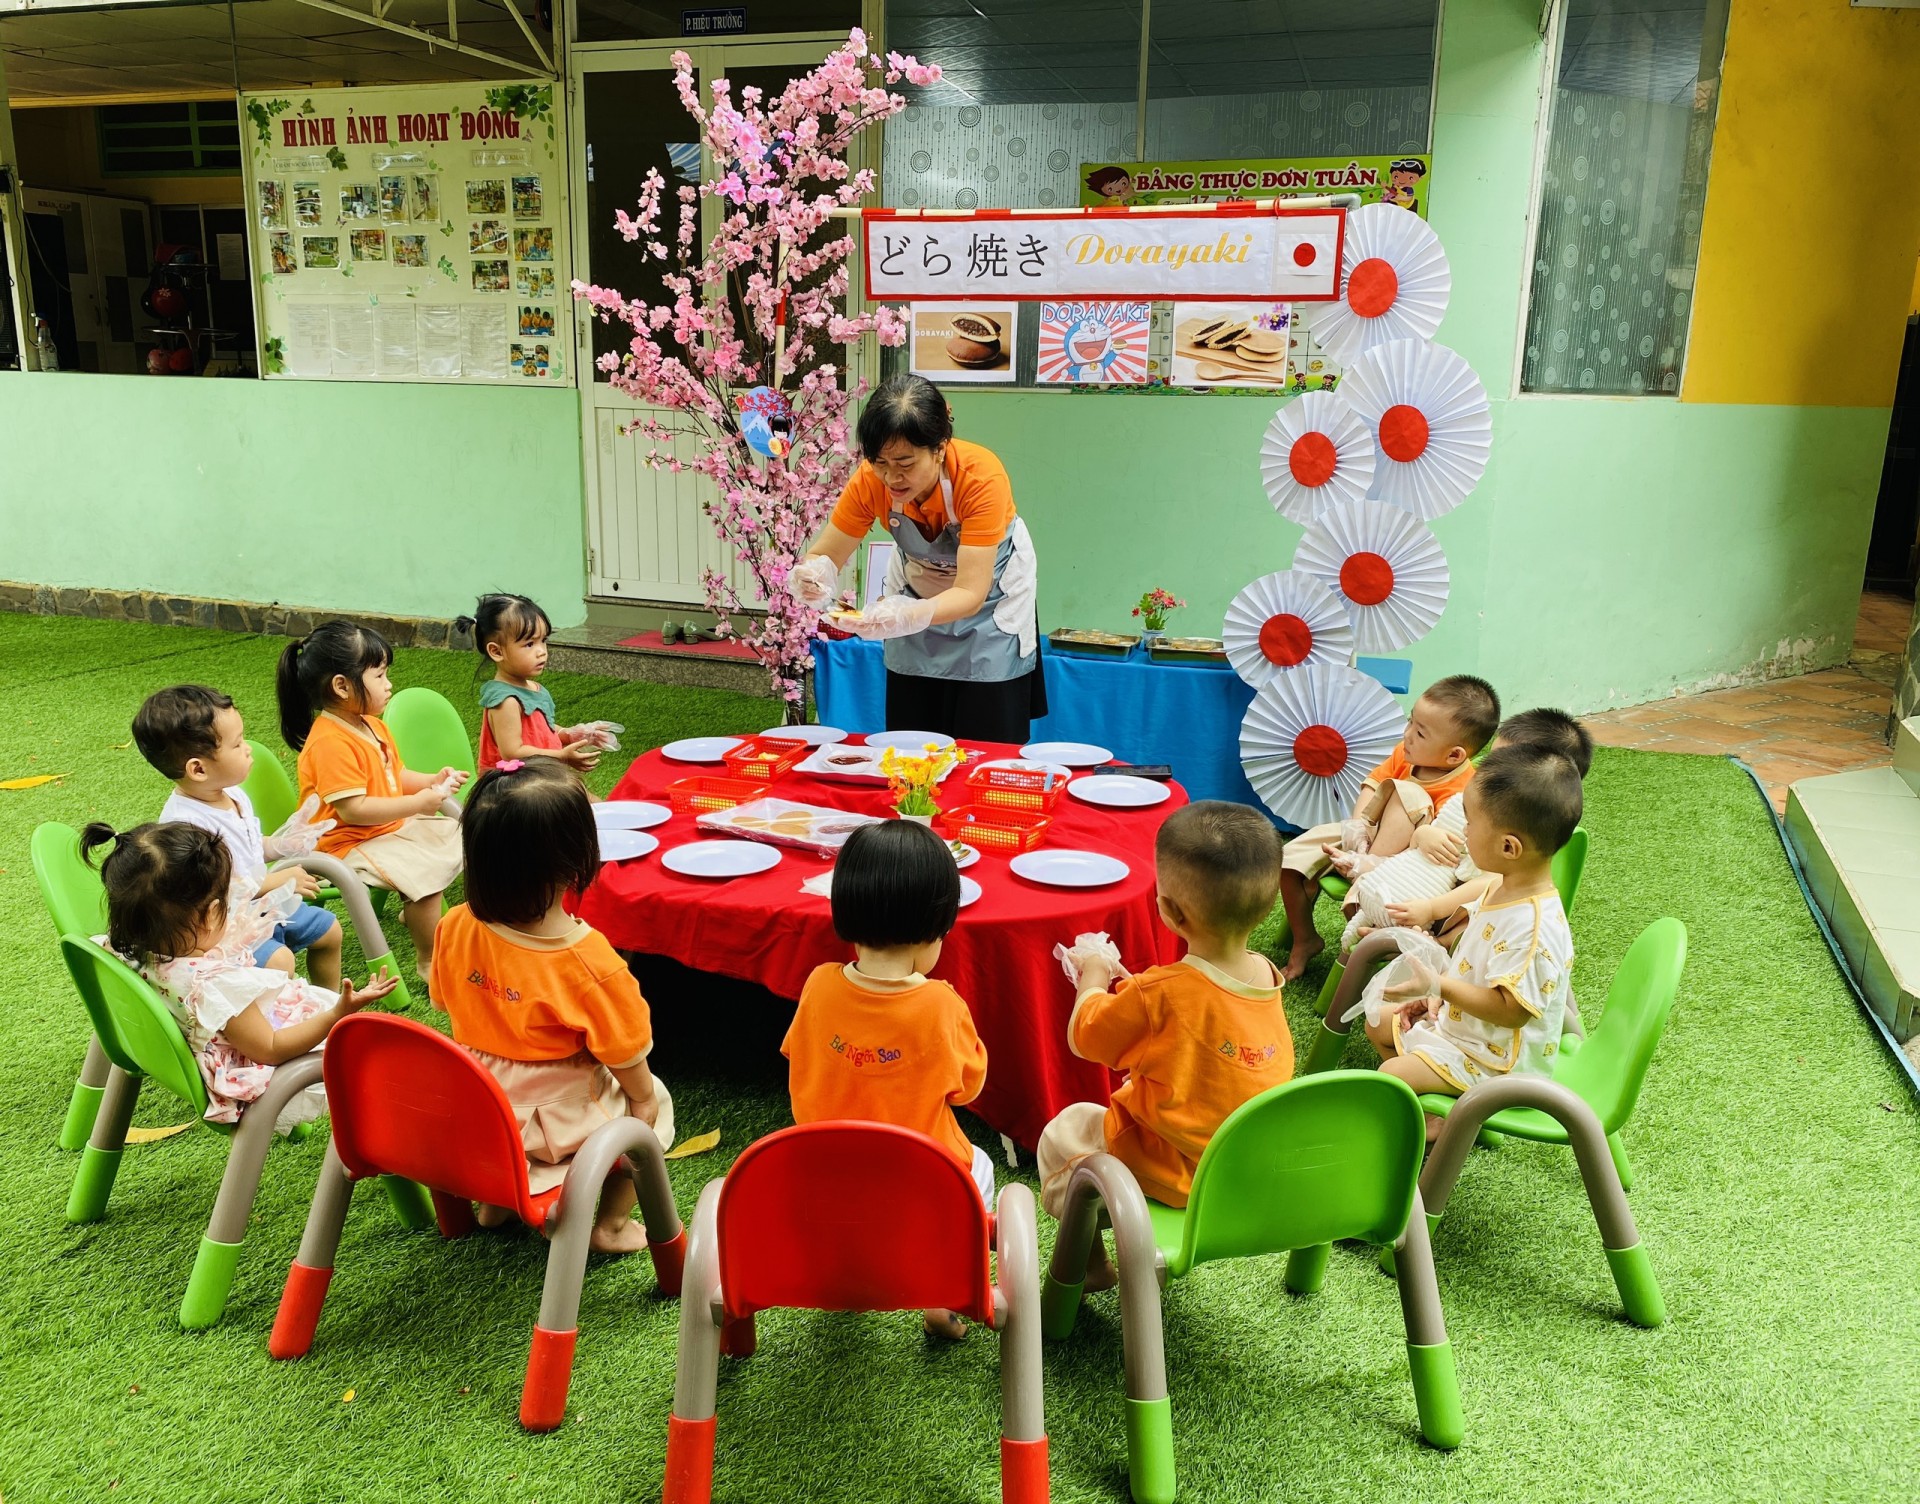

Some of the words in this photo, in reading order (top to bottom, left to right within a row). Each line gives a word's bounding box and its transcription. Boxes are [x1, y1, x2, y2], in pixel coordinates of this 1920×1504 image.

[712, 10, 743, 29] TRƯỜNG
[282, 112, 337, 147] HÌNH
[346, 107, 389, 145] ẢNH
[397, 113, 450, 148] HOẠT
[460, 105, 520, 146] ĐỘNG
[1136, 168, 1194, 190] BẢNG
[1200, 169, 1258, 193] THỰC
[1261, 170, 1309, 189] ĐƠN
[1314, 162, 1377, 187] TUẦN
[880, 233, 1048, 278] どら焼き
[1066, 231, 1253, 270] Dorayaki
[1042, 303, 1150, 323] DORAYAKI
[467, 969, 485, 987] Bé
[829, 1034, 848, 1053] Bé
[846, 1044, 875, 1067] Ngôi
[877, 1048, 901, 1064] Sao
[1218, 1040, 1238, 1058] Bé
